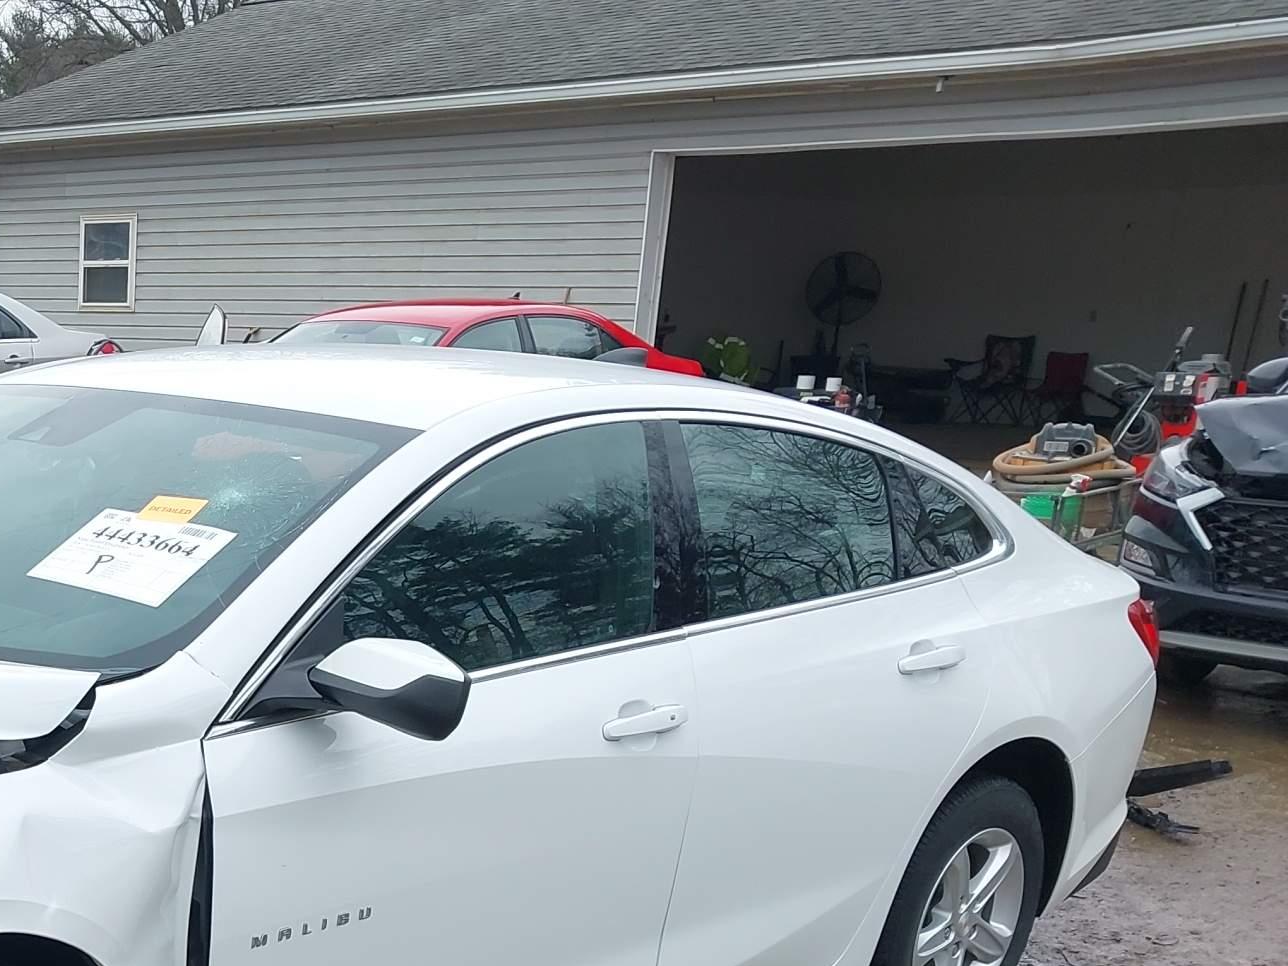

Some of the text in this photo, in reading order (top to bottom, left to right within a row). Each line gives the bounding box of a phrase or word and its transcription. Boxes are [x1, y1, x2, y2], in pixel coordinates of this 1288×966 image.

[148, 505, 192, 516] DETAILED
[92, 526, 201, 557] 44433664
[86, 554, 115, 575] P
[251, 906, 372, 949] MALIBU
